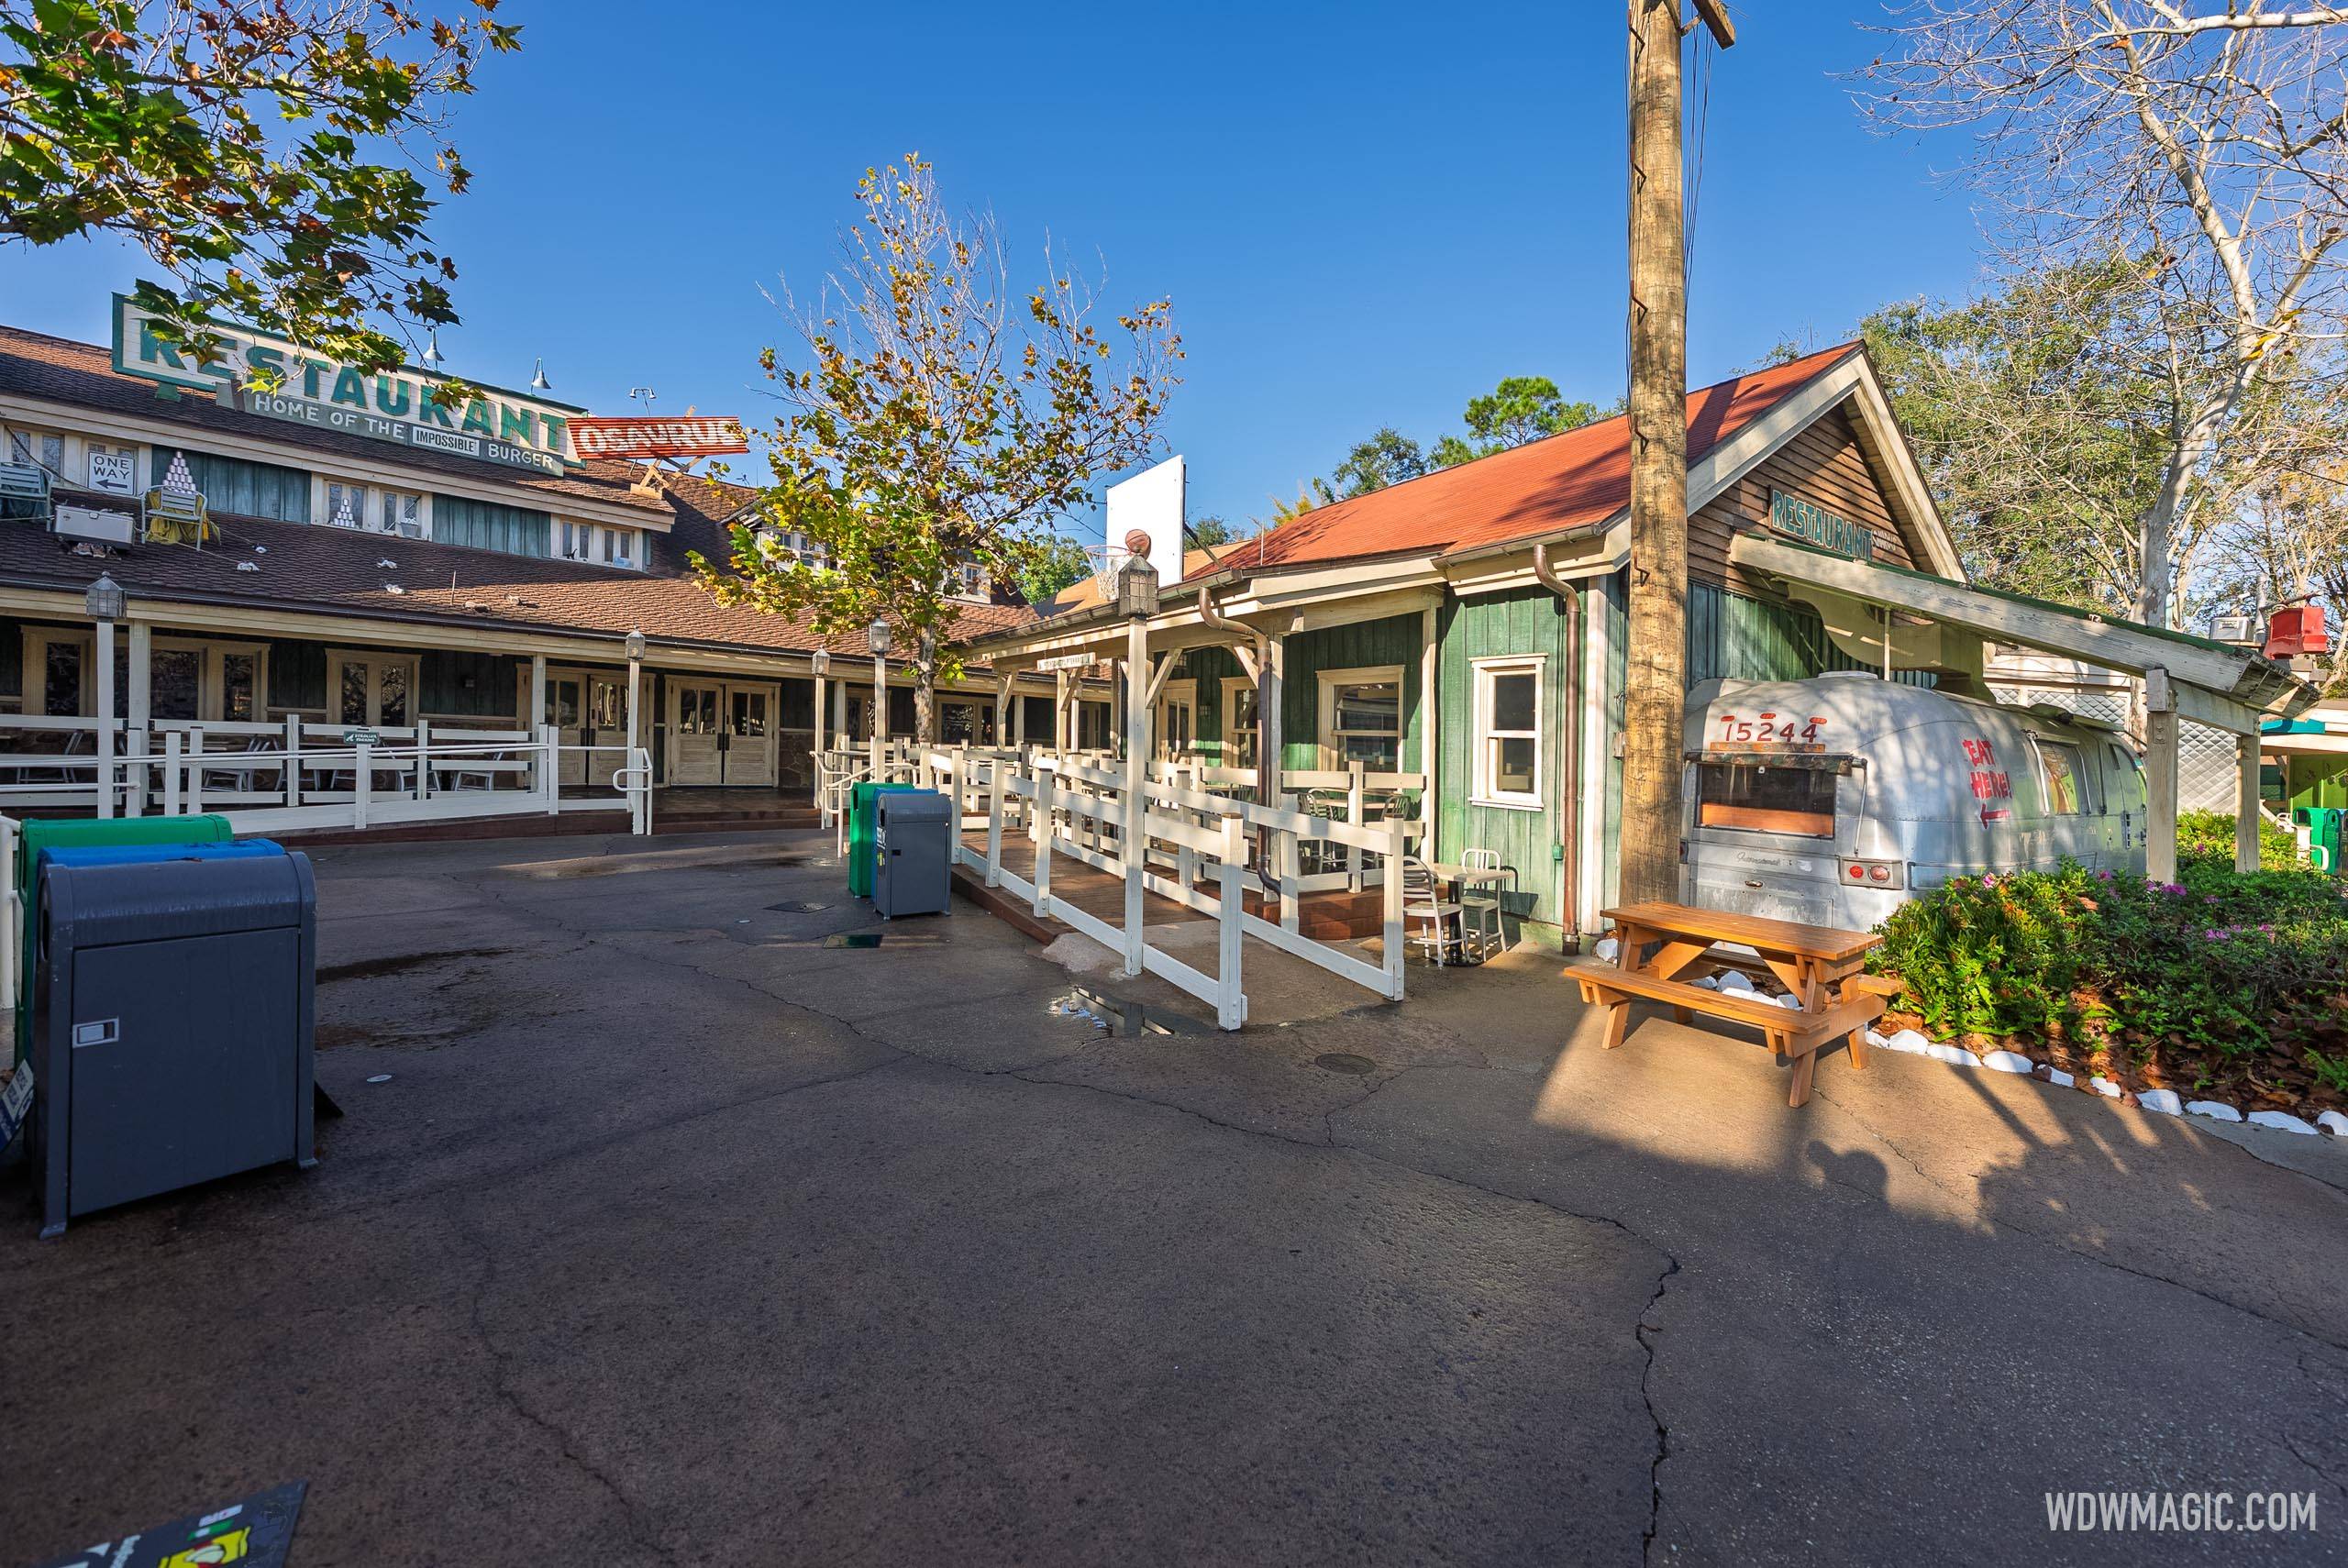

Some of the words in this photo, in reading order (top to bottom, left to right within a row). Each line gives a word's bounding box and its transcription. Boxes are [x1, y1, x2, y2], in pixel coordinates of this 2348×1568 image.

[140, 318, 566, 450] RESTAURANT
[255, 393, 319, 422] HOME
[329, 412, 358, 428] OF
[364, 417, 404, 439] THE
[415, 429, 474, 452] IMPOSSIBLE
[488, 443, 554, 469] BURGER
[578, 419, 747, 453] OSAURUS
[94, 456, 129, 469] ONE
[94, 466, 129, 480] WAY
[1772, 489, 1874, 560] RESTAURANT
[1725, 722, 1817, 744] 15244
[1962, 738, 1996, 767] EAT
[1970, 770, 2012, 799] HERE!
